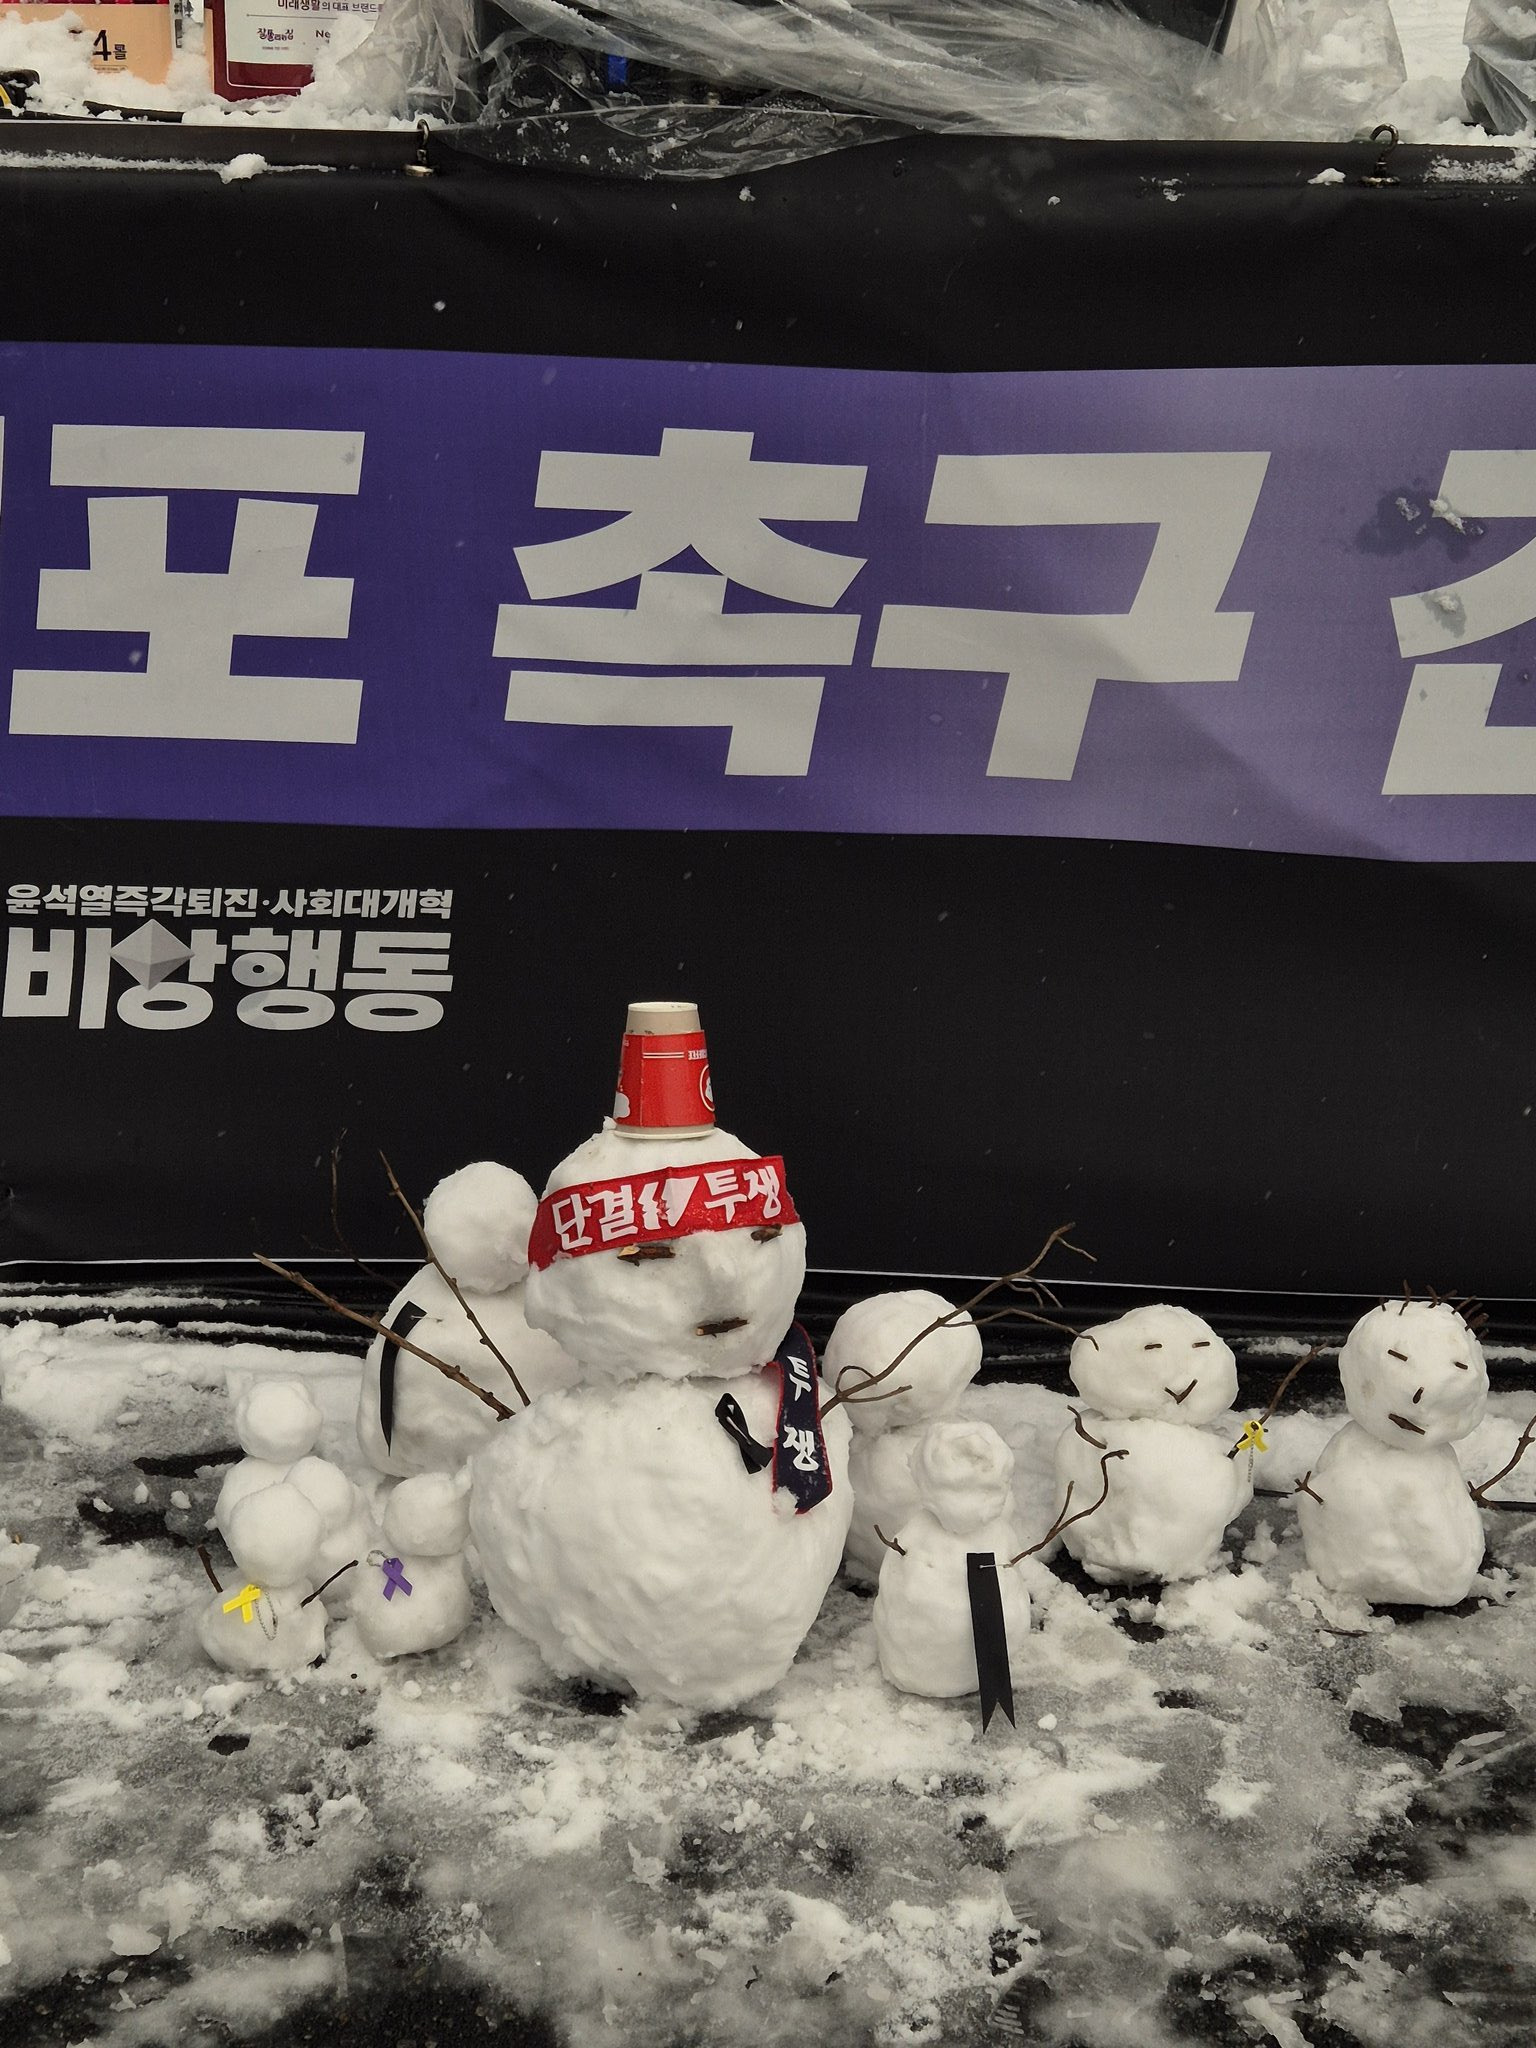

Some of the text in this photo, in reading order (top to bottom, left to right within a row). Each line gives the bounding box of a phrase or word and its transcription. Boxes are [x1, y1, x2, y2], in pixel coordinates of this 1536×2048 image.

[315, 29, 331, 39] Ne
[0, 415, 365, 744] 포
[492, 427, 1271, 781] 촉구
[6, 884, 453, 919] 윤석열즉각퇴진·사회대개혁
[2, 926, 453, 1032] 비상행동
[552, 1165, 782, 1250] 단결 투쟁
[782, 1355, 819, 1472] 투쟁
